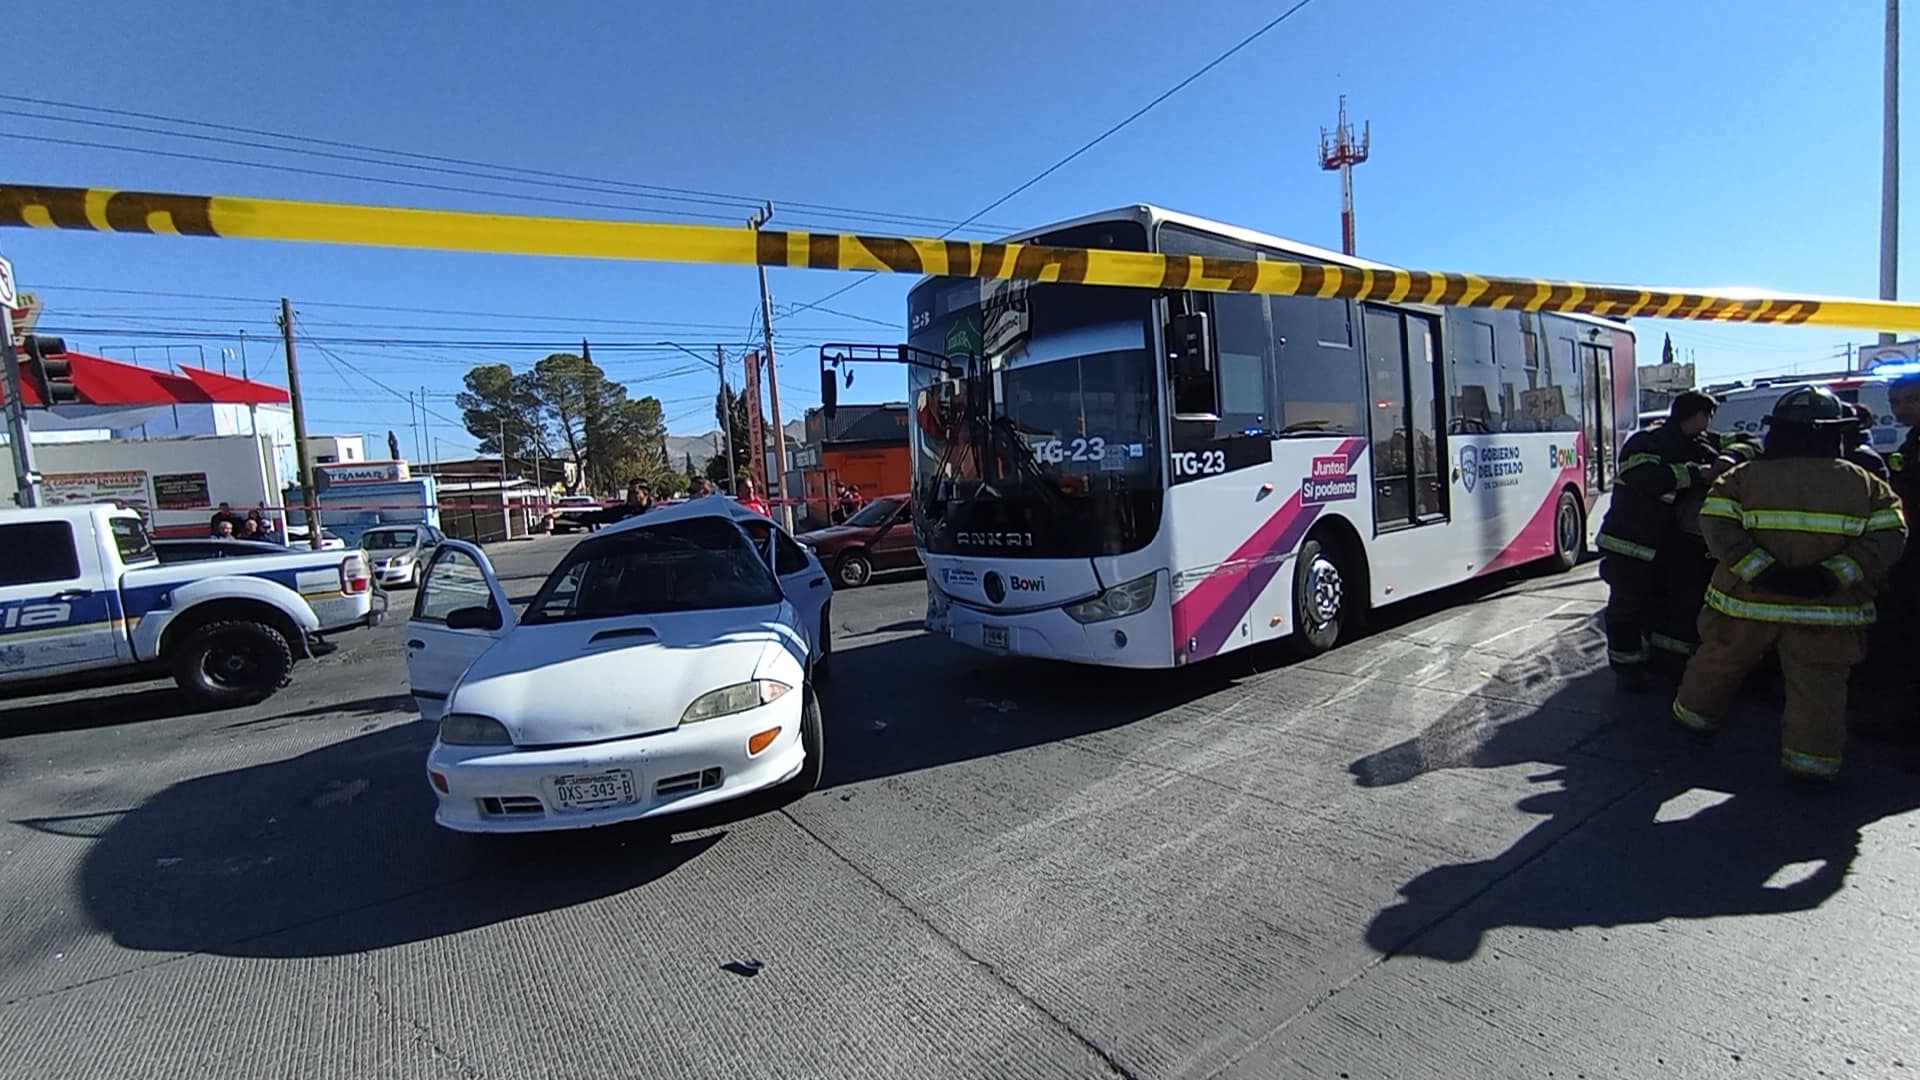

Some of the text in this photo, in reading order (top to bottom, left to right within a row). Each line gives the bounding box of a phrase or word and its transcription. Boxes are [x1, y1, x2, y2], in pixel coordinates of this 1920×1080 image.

[1031, 437, 1106, 464] TG-23
[1481, 446, 1519, 462] GOBIERNO
[1171, 450, 1226, 476] TG-23
[1314, 460, 1345, 476] Juntos
[1478, 462, 1523, 479] DEL ESTADO
[1314, 481, 1356, 500] podemos
[956, 532, 1033, 547] ANKAI
[1010, 575, 1046, 592] Bowi
